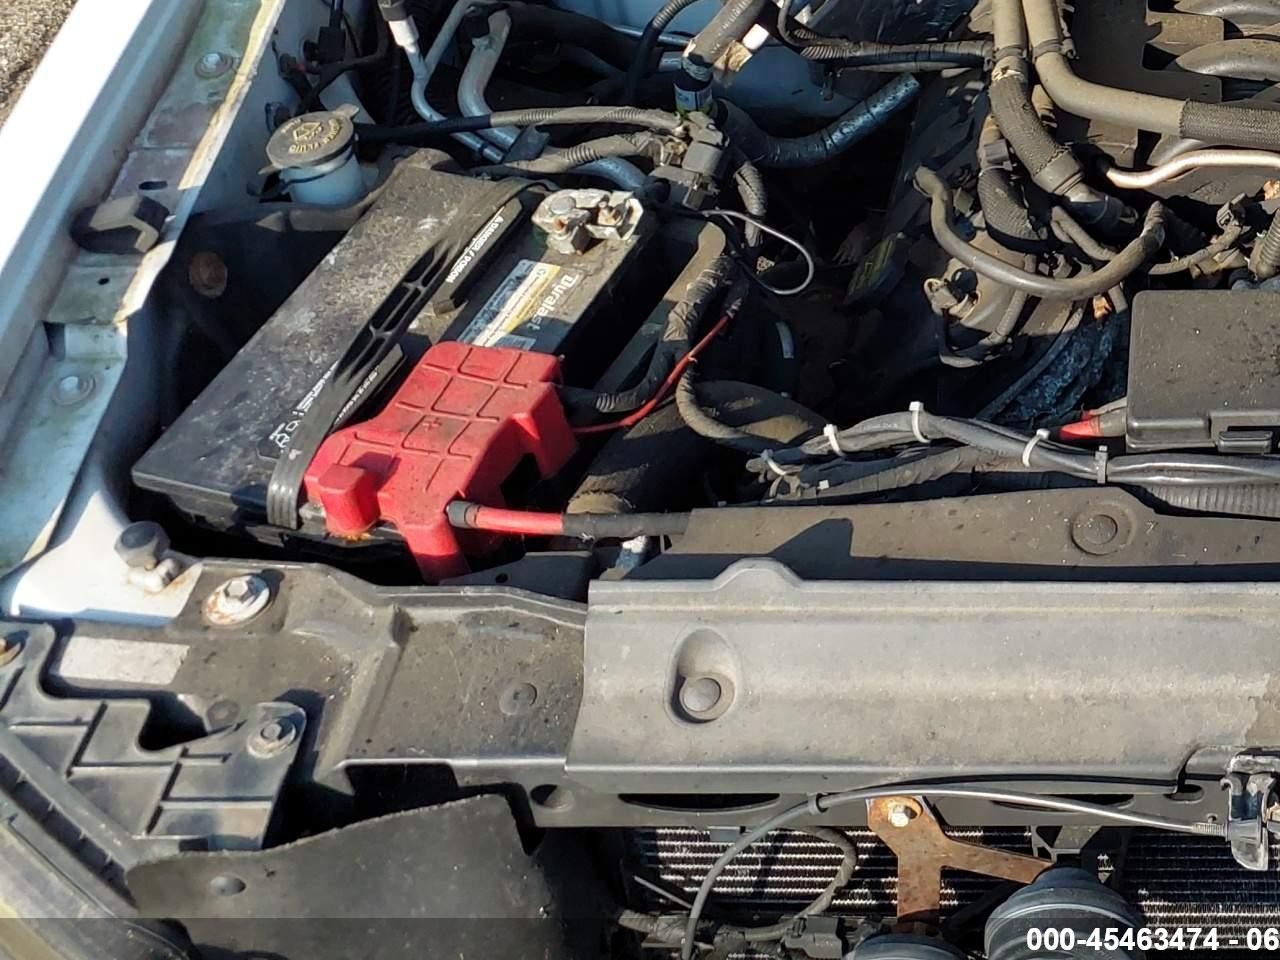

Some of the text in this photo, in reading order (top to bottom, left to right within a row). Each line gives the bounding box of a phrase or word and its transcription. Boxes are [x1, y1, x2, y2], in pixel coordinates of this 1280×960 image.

[474, 220, 500, 253] DANGER
[445, 256, 473, 284] POISON
[525, 272, 580, 331] Duralast
